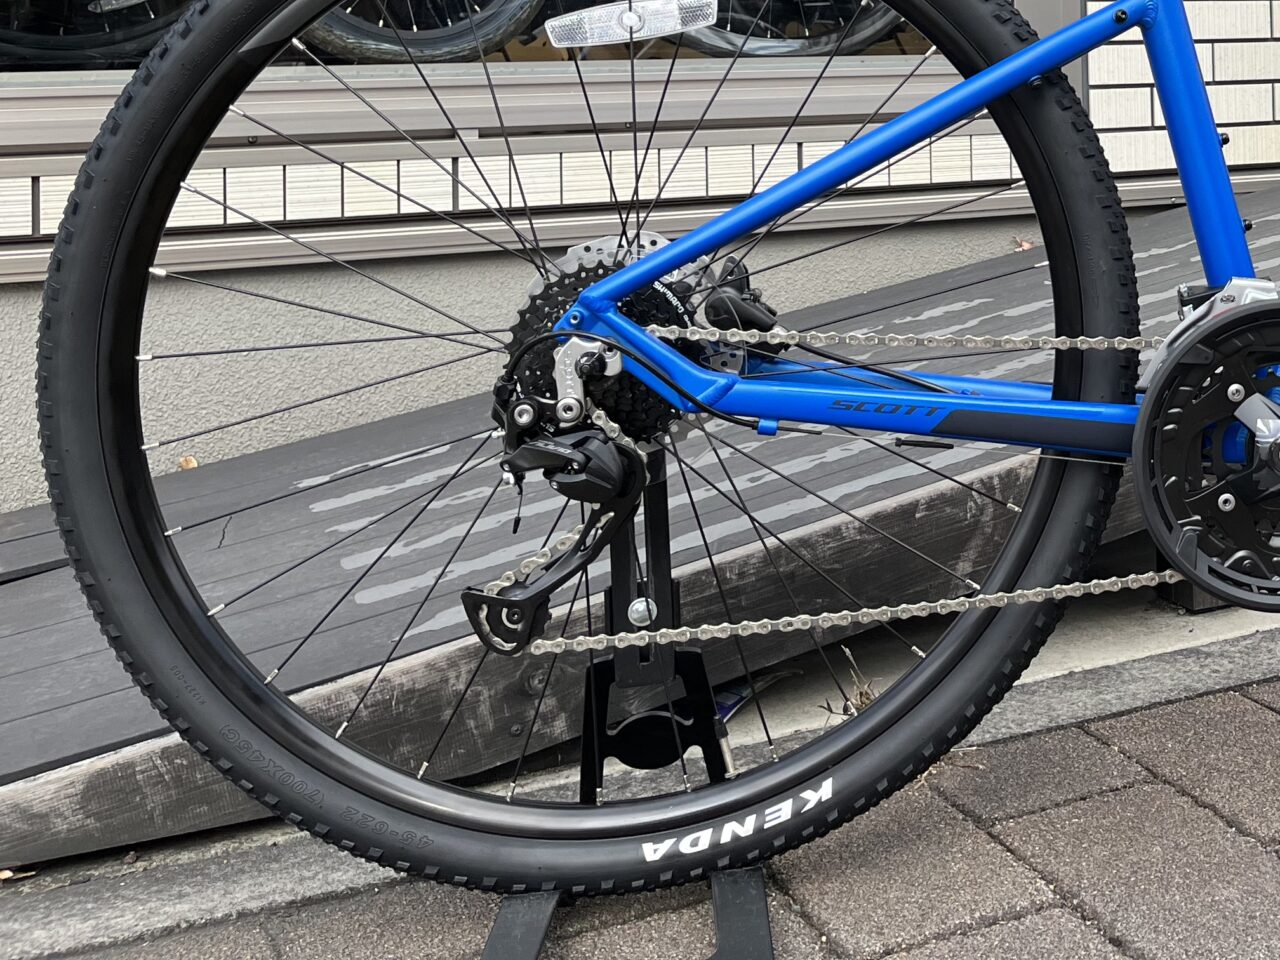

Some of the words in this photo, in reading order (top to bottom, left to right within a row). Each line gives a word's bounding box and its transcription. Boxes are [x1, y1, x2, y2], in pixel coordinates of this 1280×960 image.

[652, 280, 684, 313] SHIMANO
[828, 400, 946, 417] SCOTT
[641, 776, 833, 863] KENDA
